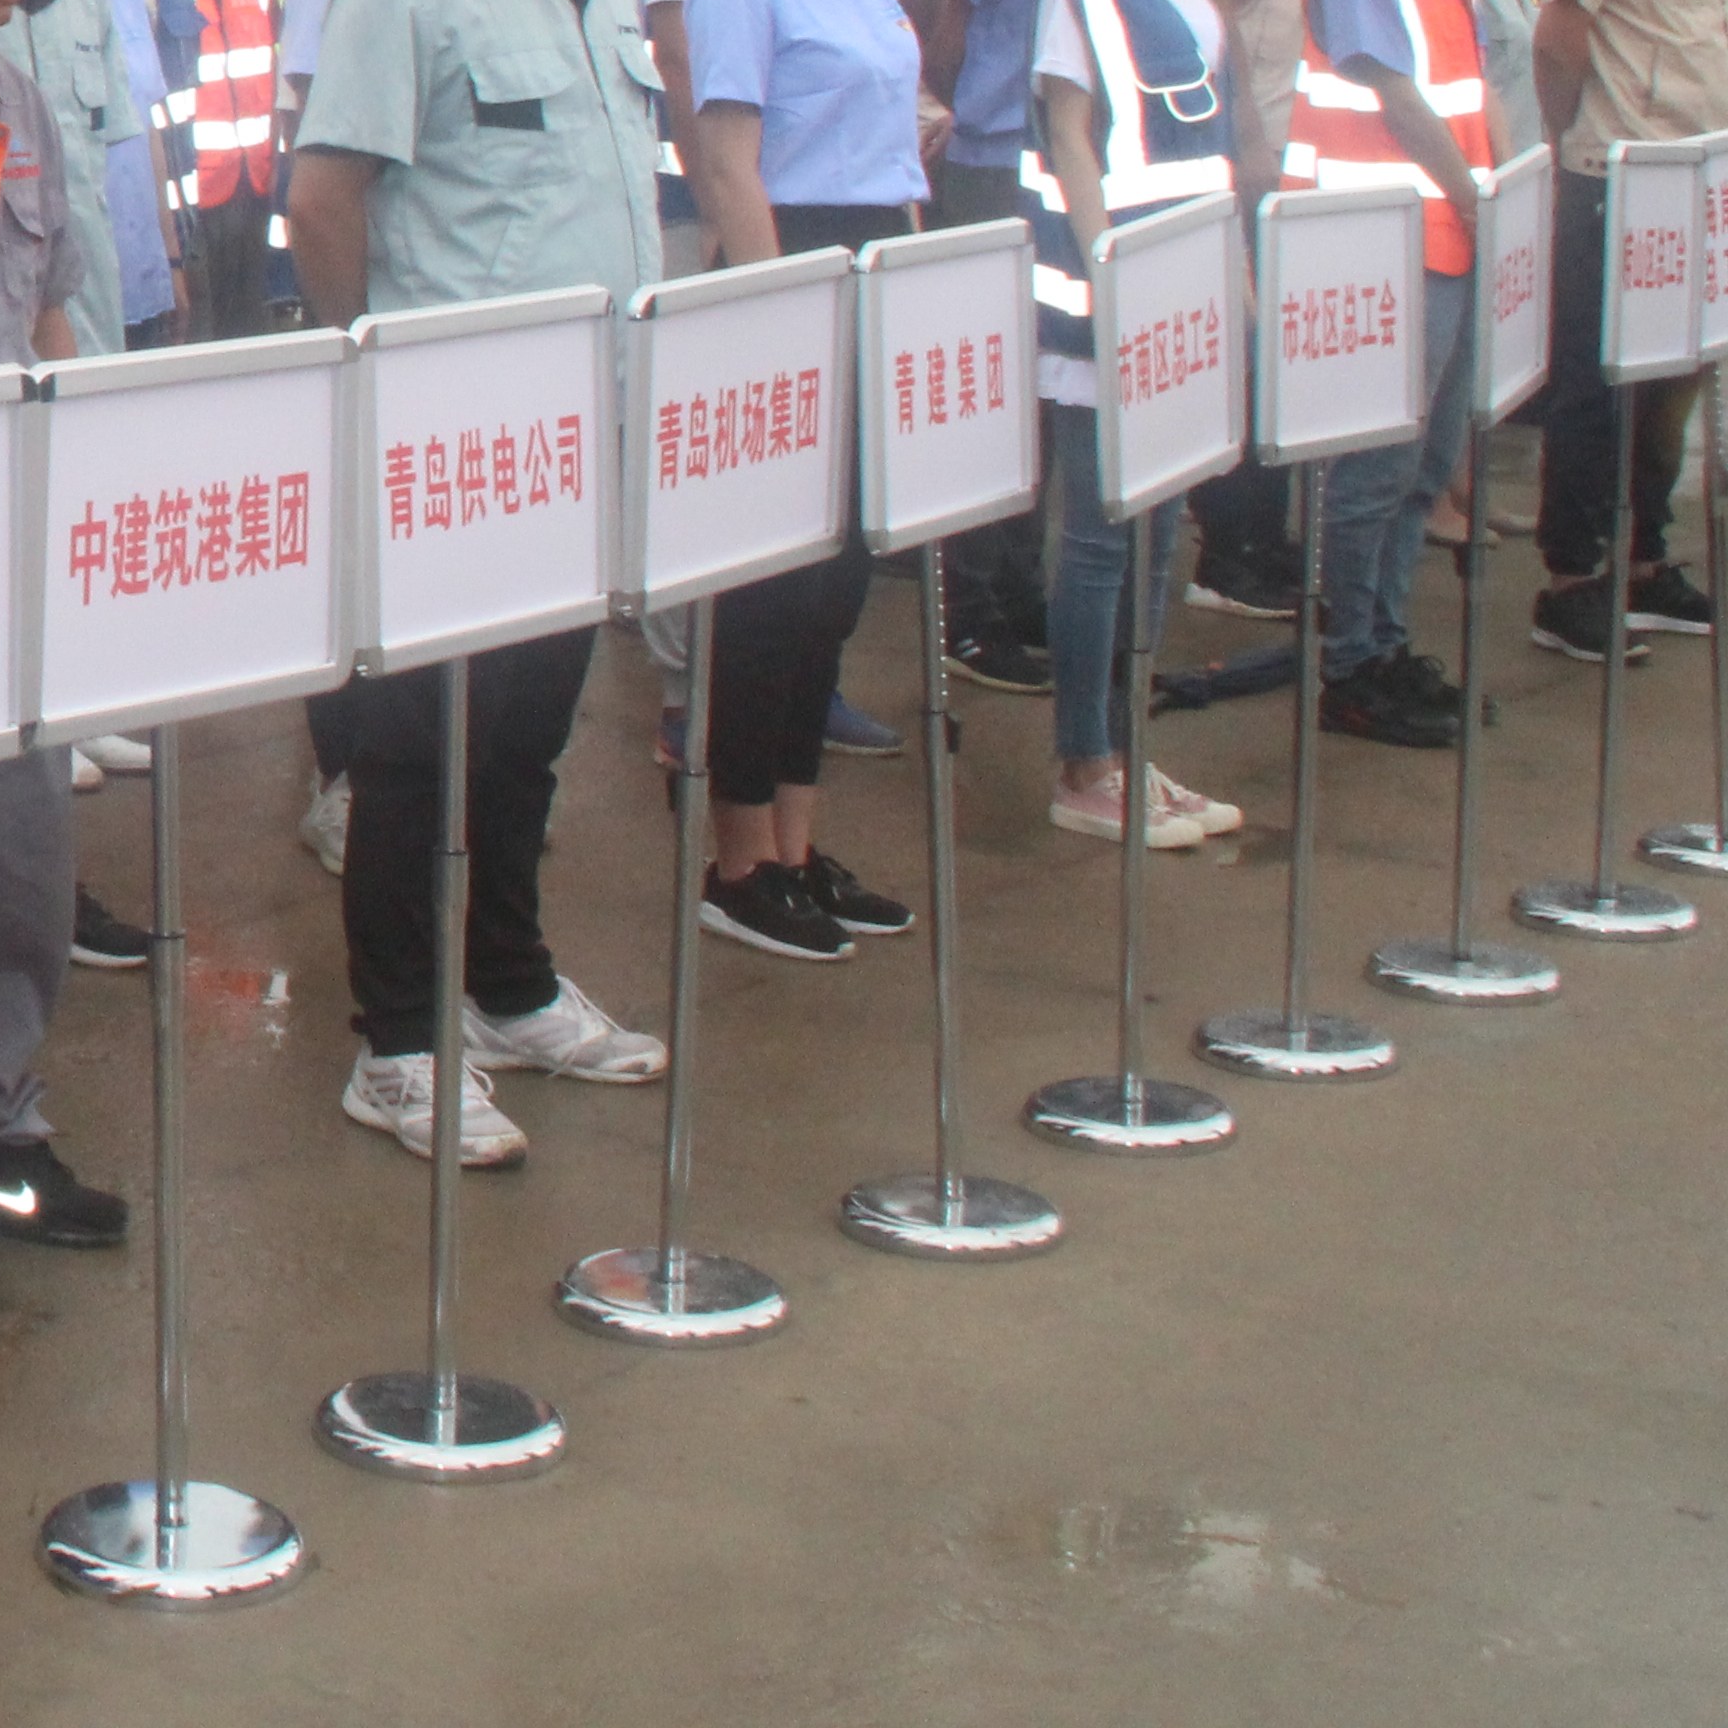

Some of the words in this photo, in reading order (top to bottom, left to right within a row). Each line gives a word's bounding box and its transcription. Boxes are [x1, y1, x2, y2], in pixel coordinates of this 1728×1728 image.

[1117, 296, 1220, 411] 市南区总工会
[1281, 278, 1397, 365] 市北区总工会
[656, 367, 820, 491] 青岛机场集团
[893, 332, 1005, 436] 青建集团
[384, 413, 584, 541] 青岛供电公司
[69, 470, 310, 607] 中建筑港集团
